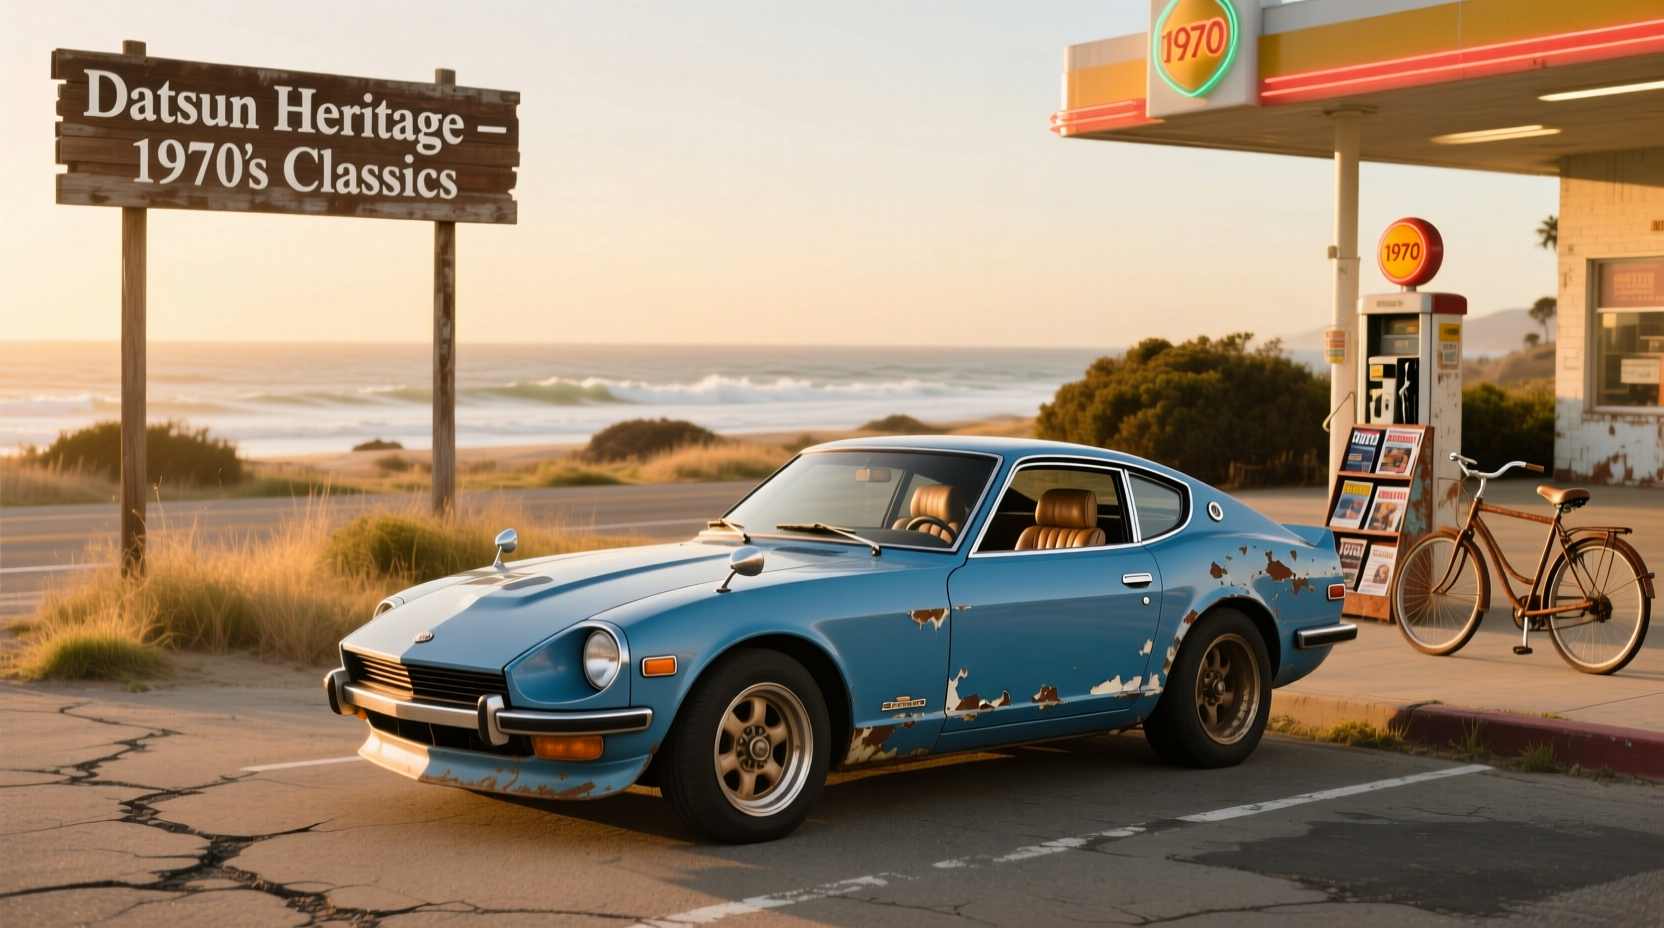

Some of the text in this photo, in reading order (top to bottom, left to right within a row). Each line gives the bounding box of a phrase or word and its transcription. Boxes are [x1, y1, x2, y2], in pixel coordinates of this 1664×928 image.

[1162, 20, 1225, 63] 1970
[83, 69, 259, 129] Datsun
[274, 85, 465, 155] Heritage
[134, 139, 458, 199] 1970's Classics
[1385, 242, 1420, 262] 1970
